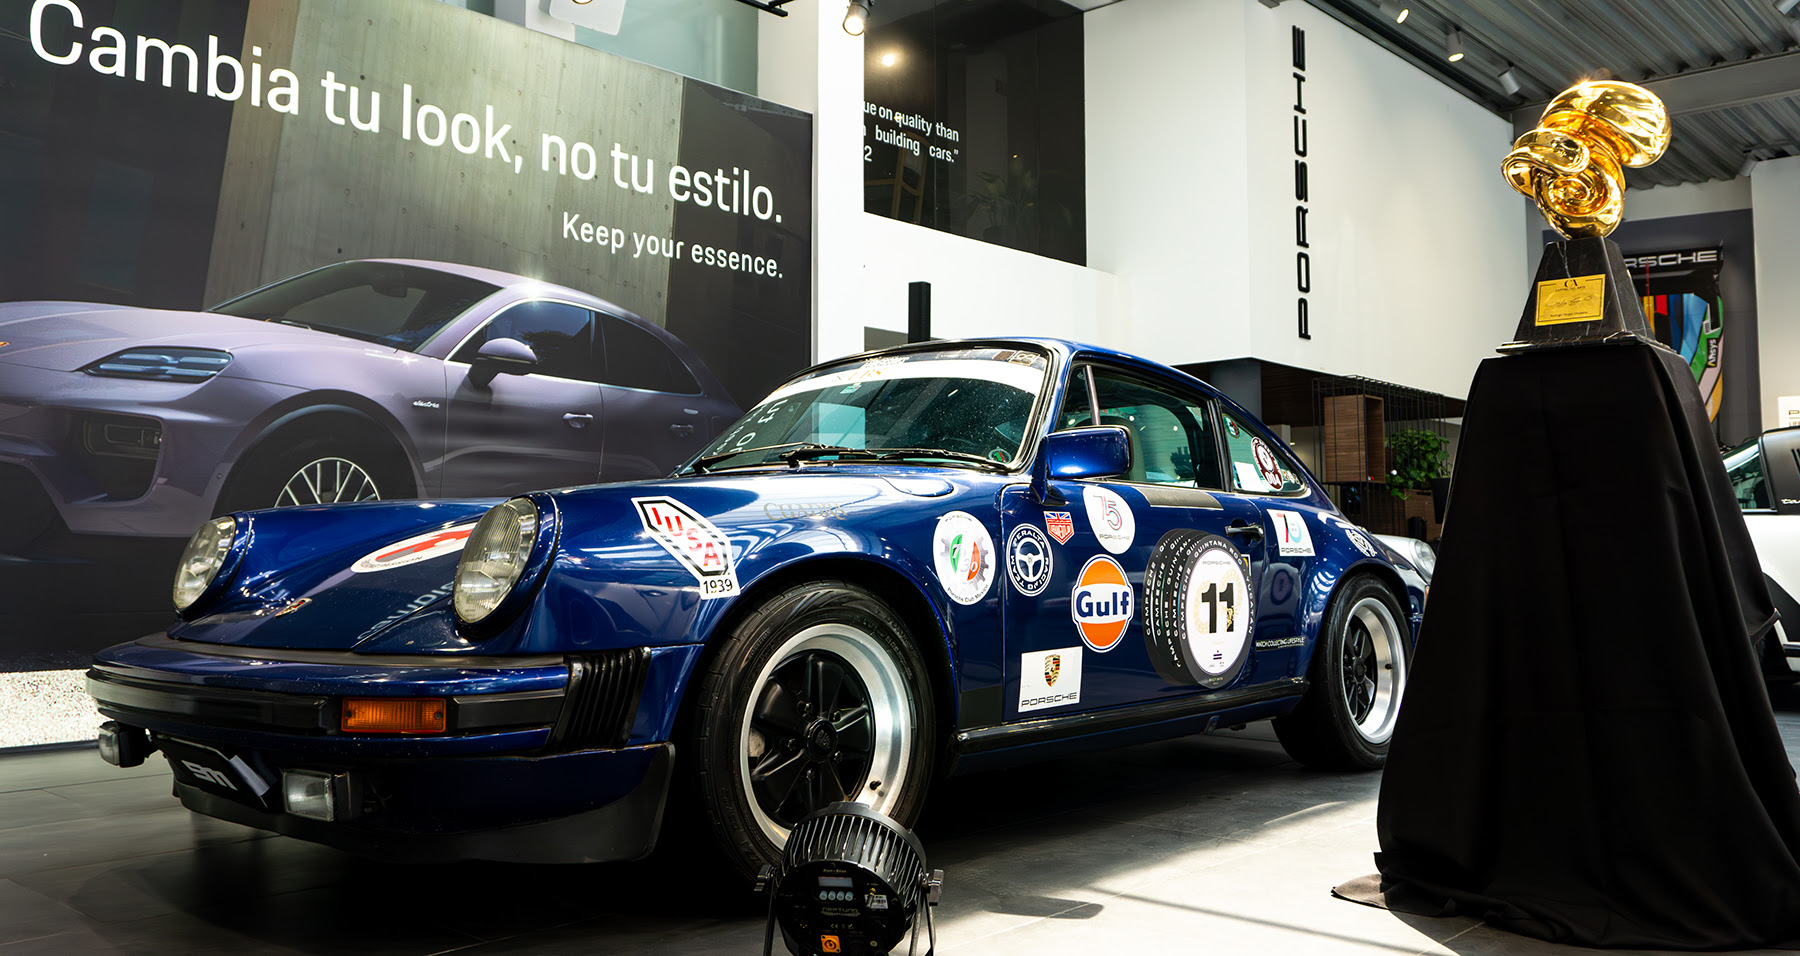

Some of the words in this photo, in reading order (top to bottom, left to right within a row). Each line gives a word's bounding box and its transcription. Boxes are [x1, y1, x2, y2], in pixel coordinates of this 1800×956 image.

[29, 0, 299, 115] Cambia
[321, 71, 380, 133] tu
[402, 83, 523, 174] look,
[541, 133, 597, 181] no
[611, 142, 654, 195] tu
[668, 164, 783, 223] estilo.
[878, 106, 893, 121] on
[894, 112, 932, 136] quality
[936, 122, 959, 142] than
[875, 125, 920, 156] building
[1293, 25, 1311, 340] PORSCHE
[563, 211, 625, 254] Keep
[632, 233, 684, 259] your
[691, 243, 783, 279] essence.
[1624, 250, 1717, 268] RSCHE
[1708, 338, 1717, 367] Ansys
[1012, 530, 1045, 549] PERALTA
[1194, 540, 1227, 558] QUINTANA
[1229, 547, 1242, 565] ROO
[703, 579, 733, 594] 1939
[1010, 555, 1025, 588] TEAM
[1027, 557, 1050, 590] RACING
[1076, 590, 1130, 618] Gulf
[1201, 583, 1234, 634] 11
[1021, 692, 1078, 707] PORSCHE
